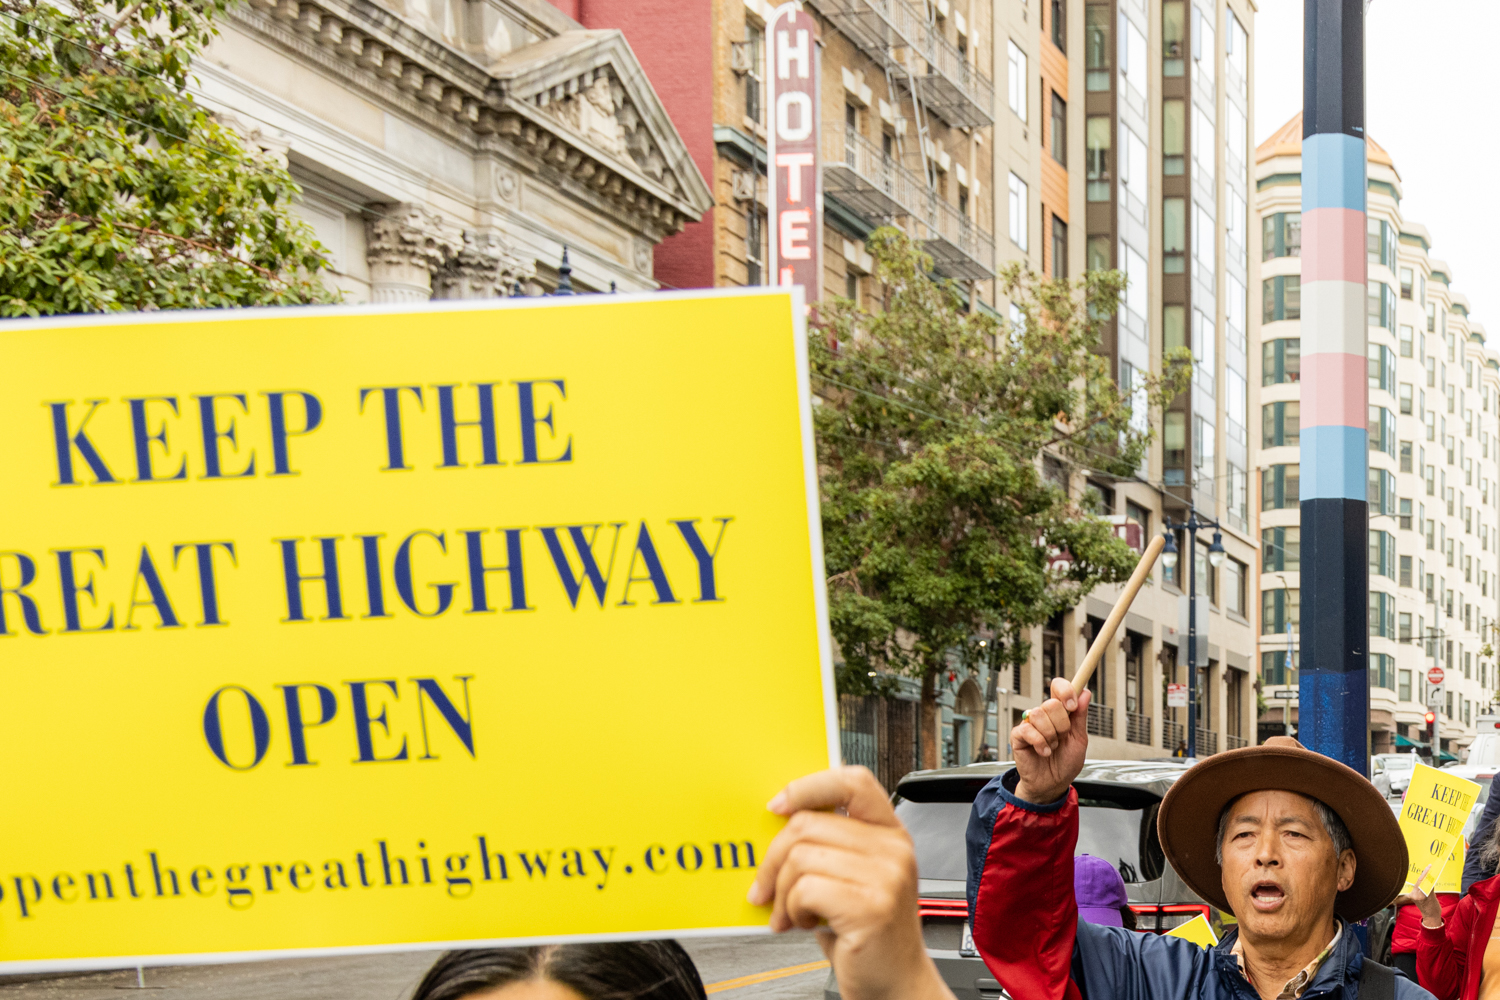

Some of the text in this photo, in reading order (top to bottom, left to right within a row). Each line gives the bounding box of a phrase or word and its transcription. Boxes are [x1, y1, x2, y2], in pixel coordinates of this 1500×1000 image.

[44, 378, 574, 487] KEEP THE
[0, 516, 735, 637] REAT HIGHWAY
[202, 675, 477, 770] OPEN
[1406, 802, 1448, 830] GREAT
[1430, 782, 1463, 807] KEEP
[0, 835, 757, 919] penthegreathighway.com
